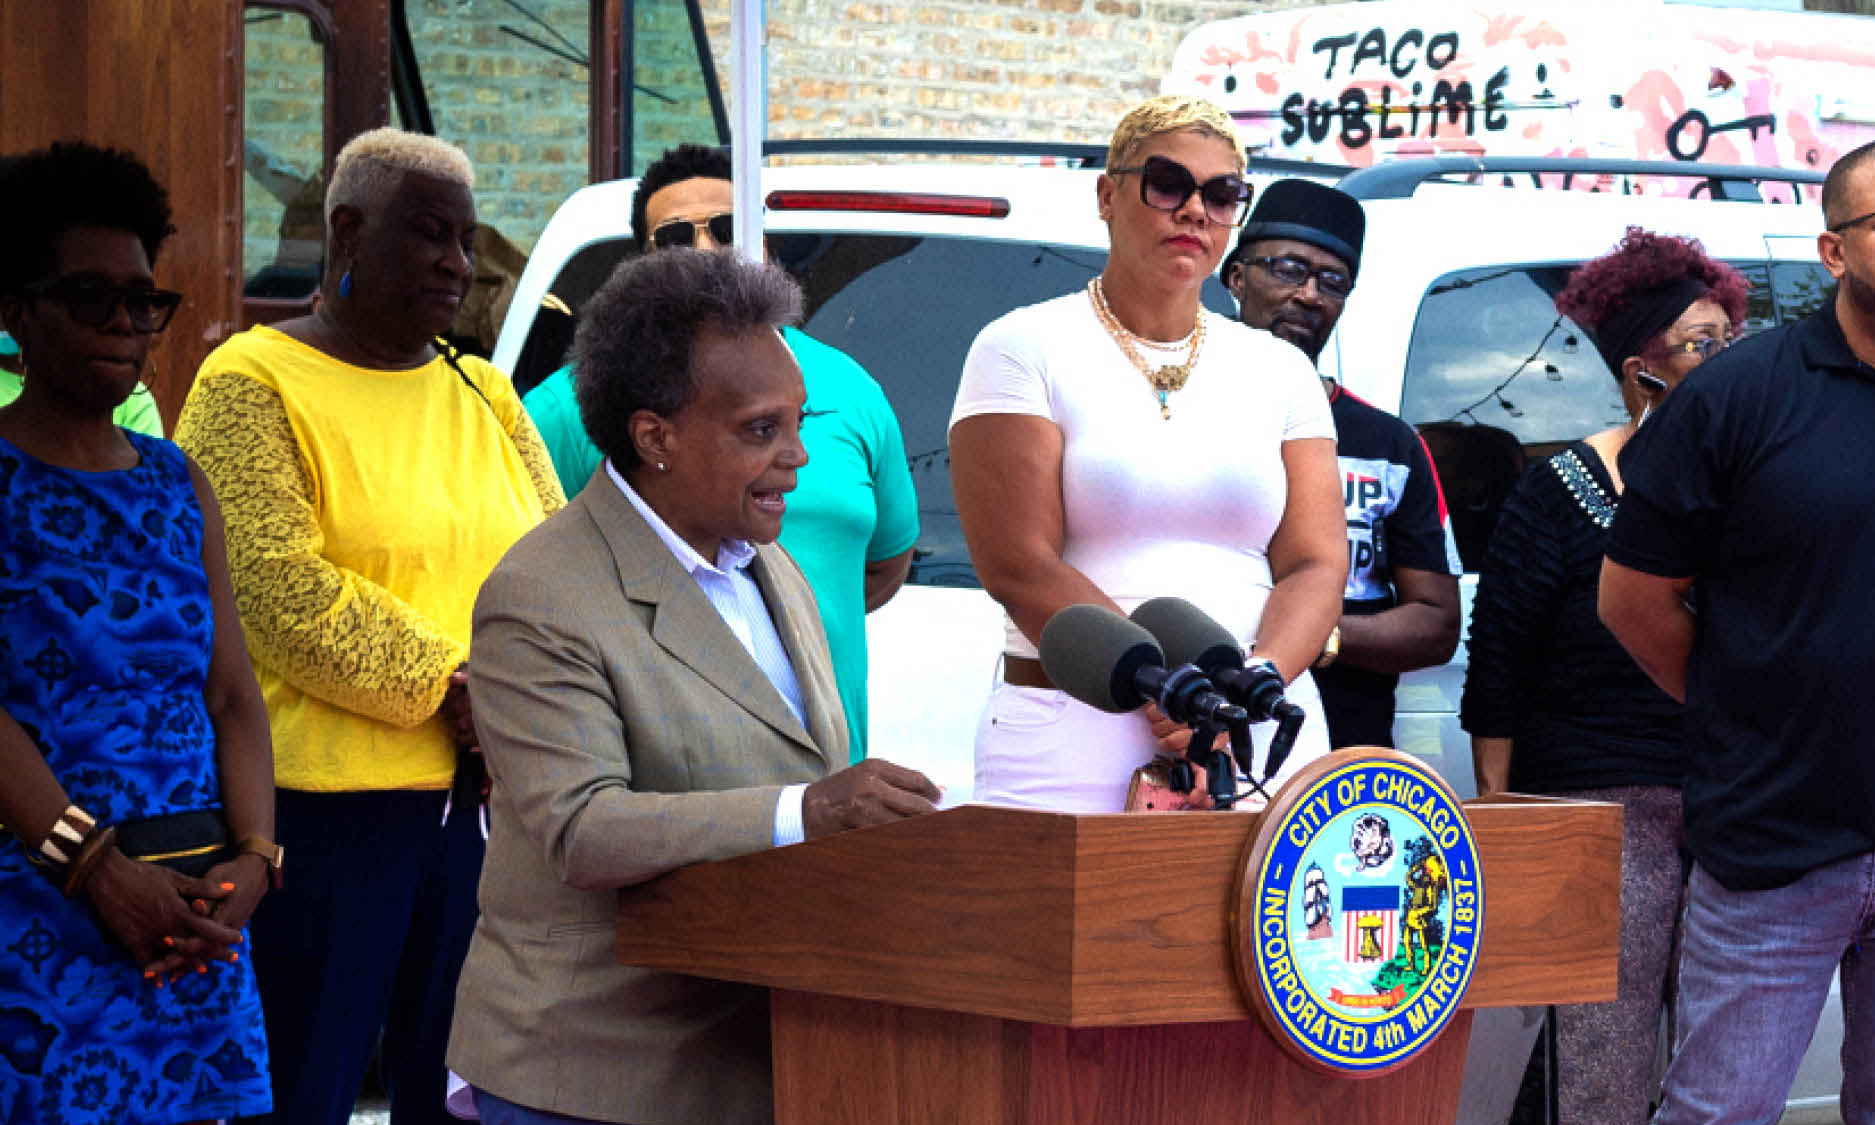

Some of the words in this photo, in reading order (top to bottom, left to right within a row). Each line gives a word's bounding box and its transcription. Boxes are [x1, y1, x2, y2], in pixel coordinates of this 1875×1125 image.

[1312, 27, 1459, 80] TACO
[1289, 790, 1332, 848] CITY
[1337, 774, 1366, 806] OF
[1373, 772, 1459, 848] CHICAGO
[1264, 887, 1367, 1053] INCORPORATED
[1373, 1021, 1406, 1049] 4th
[1405, 943, 1468, 1034] MARCH
[1455, 878, 1474, 935] 1837
